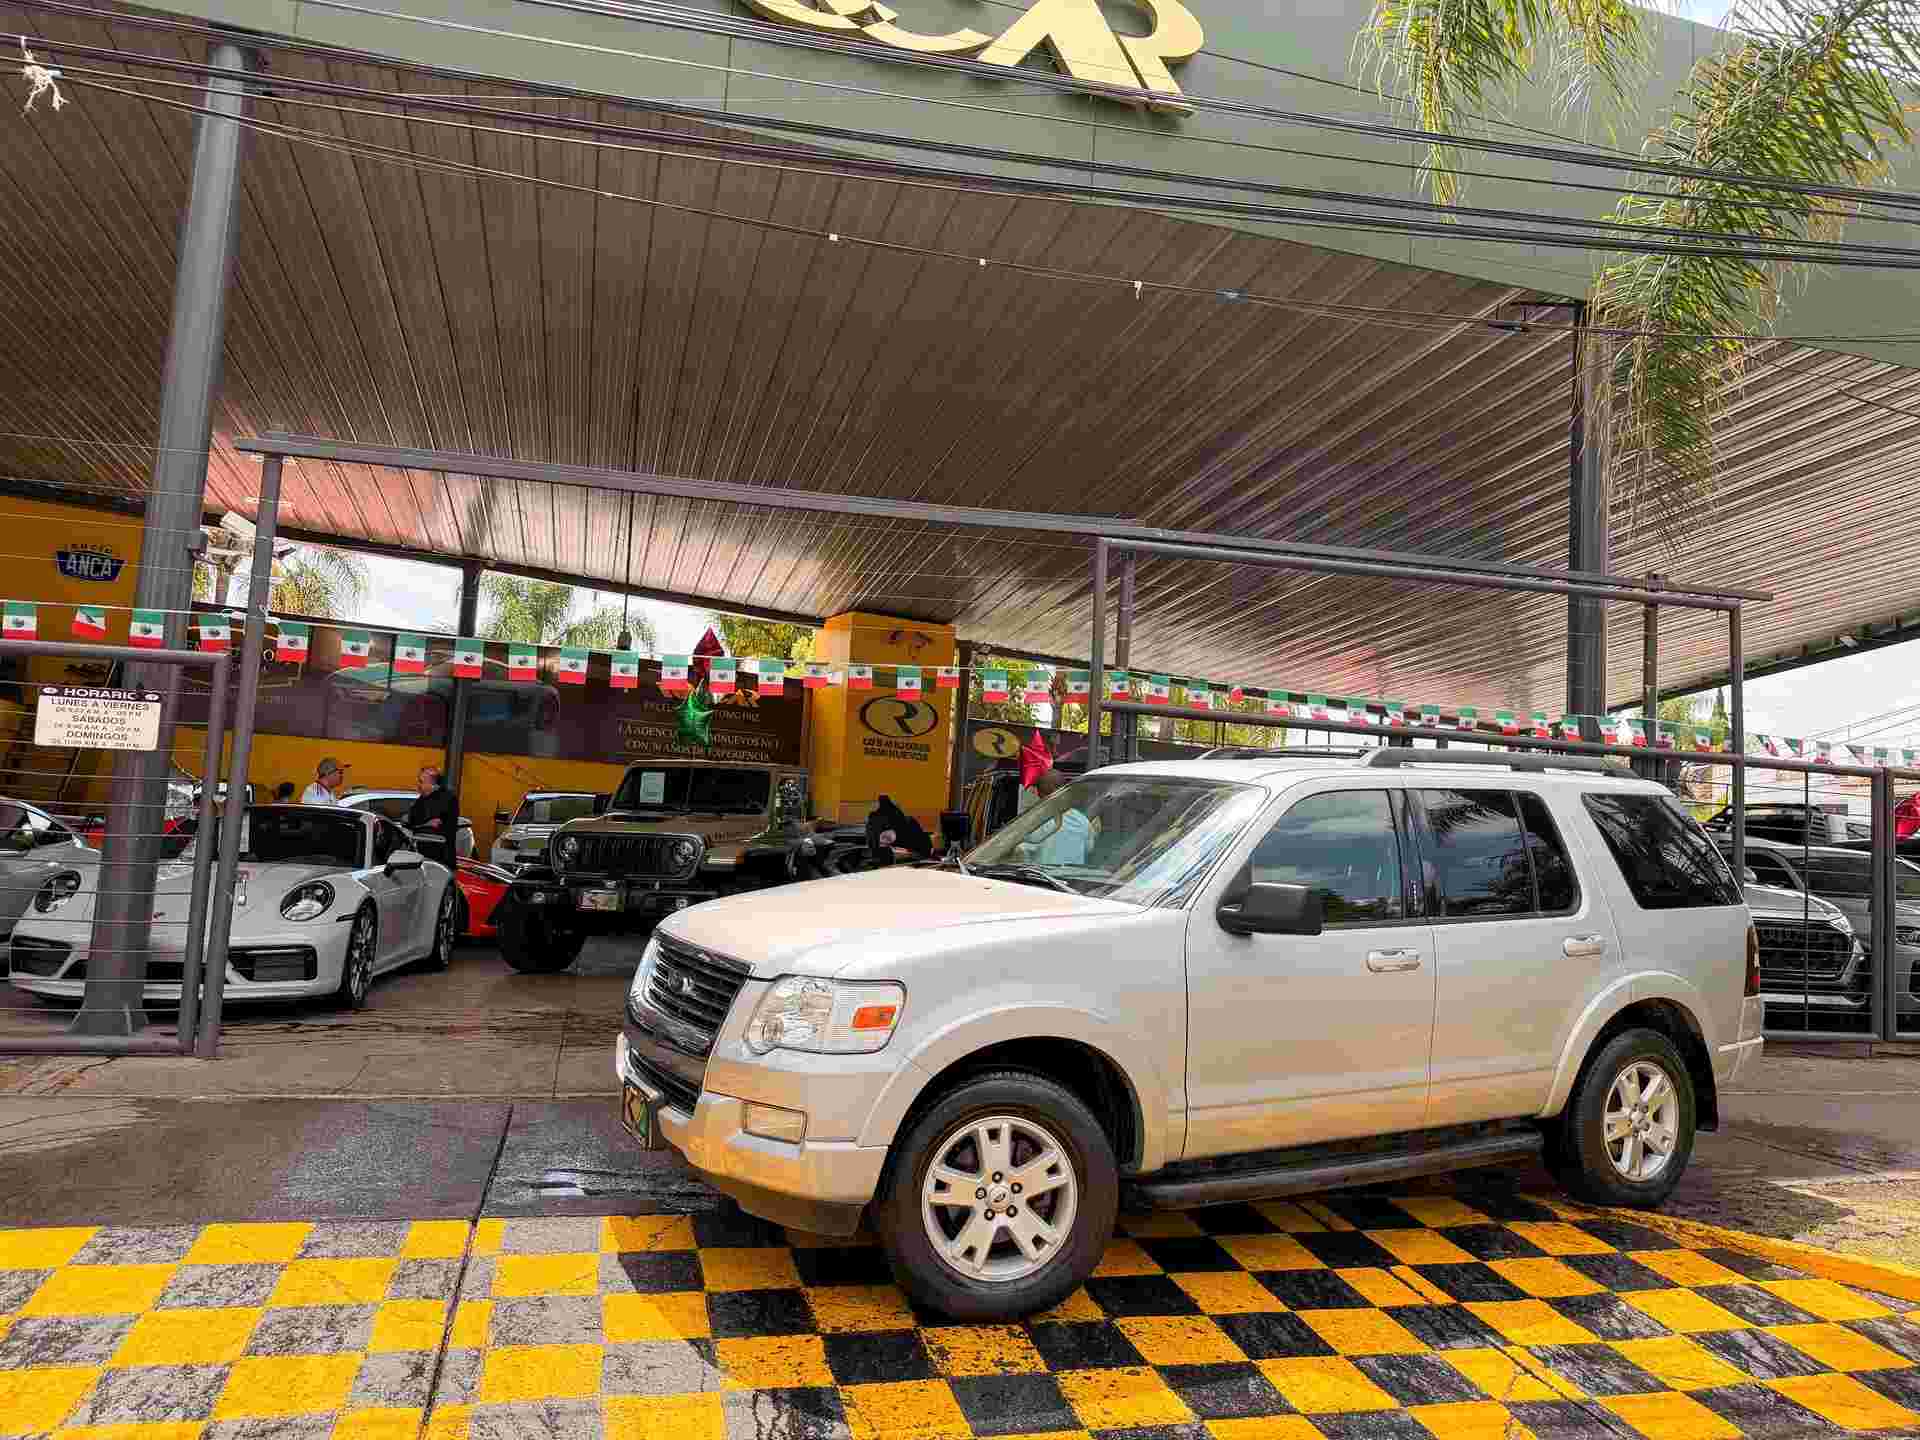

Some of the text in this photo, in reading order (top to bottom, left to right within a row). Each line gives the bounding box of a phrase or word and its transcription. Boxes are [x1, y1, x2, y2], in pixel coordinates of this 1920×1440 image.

[51, 697, 88, 707] LUNES
[103, 701, 150, 711] VIERNES
[66, 730, 128, 741] DOMINGOS
